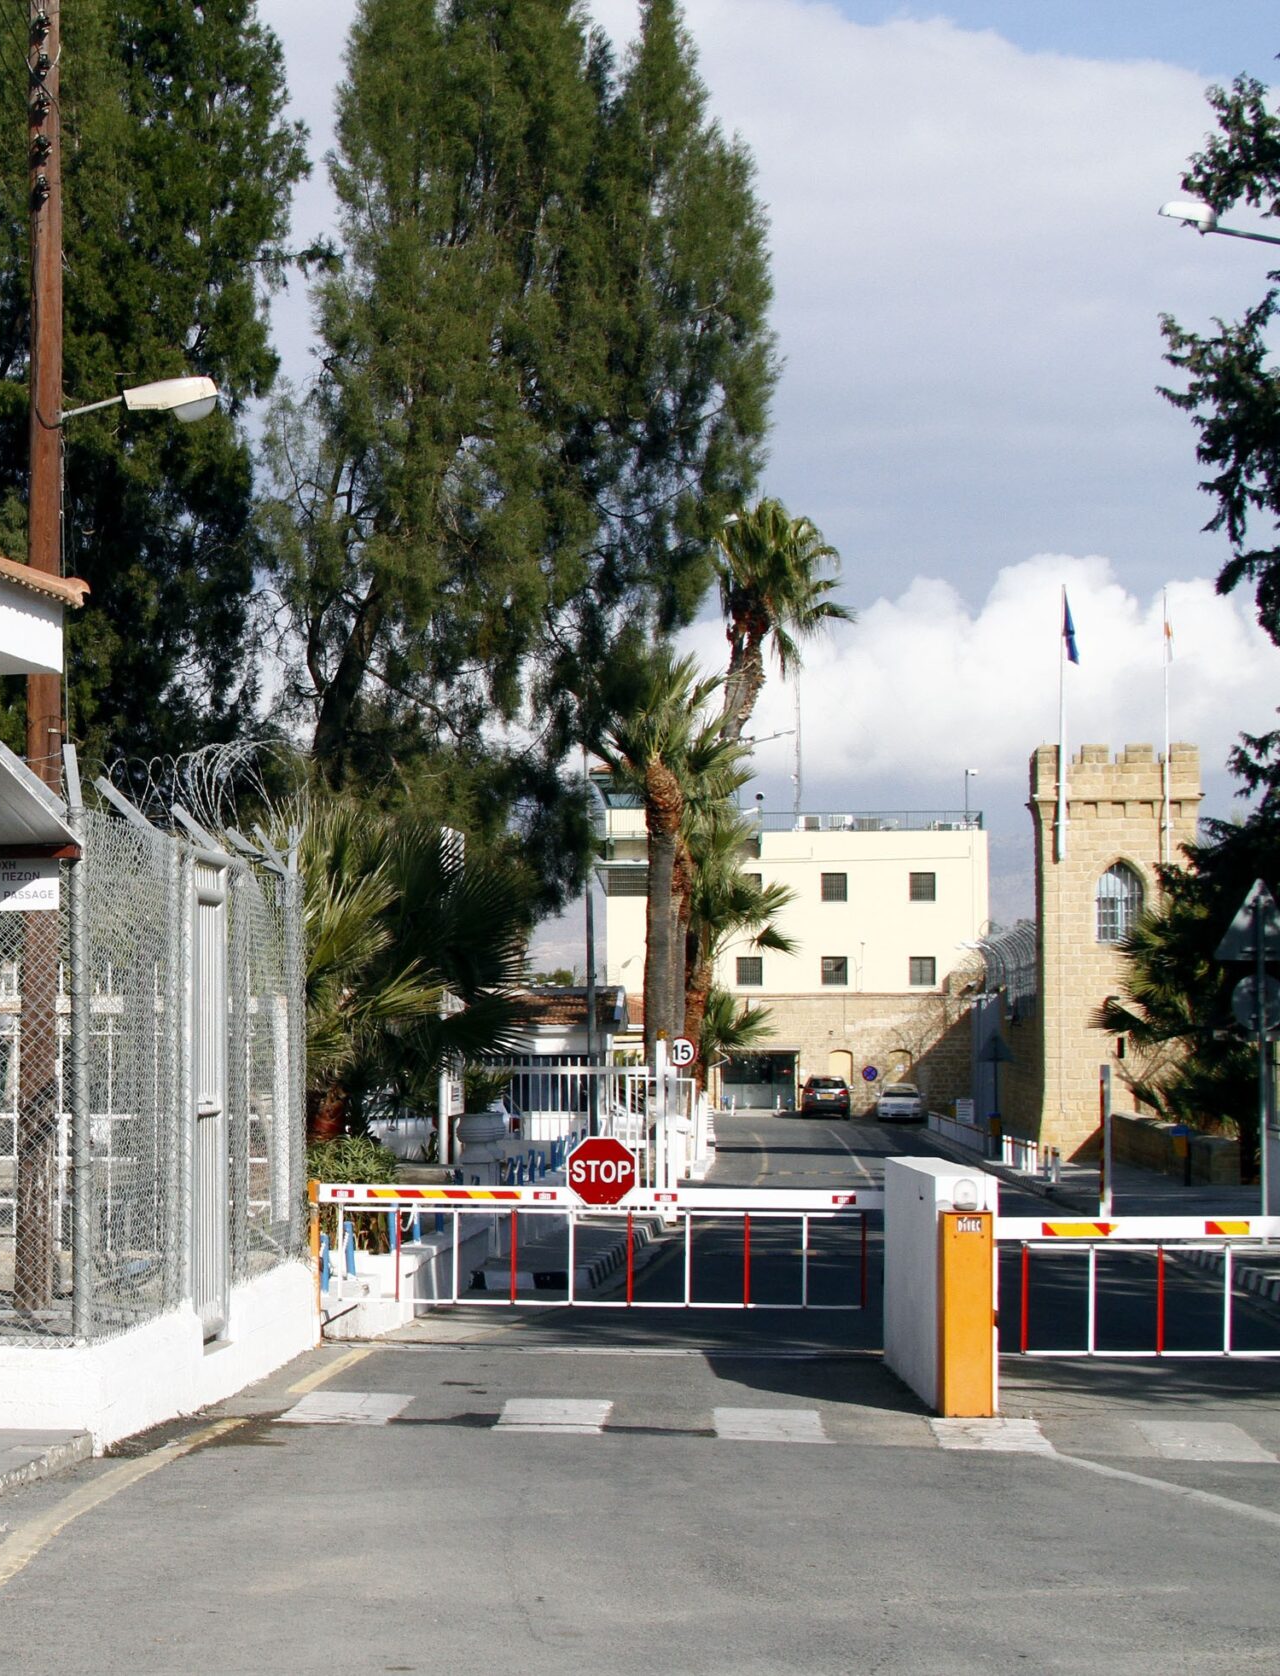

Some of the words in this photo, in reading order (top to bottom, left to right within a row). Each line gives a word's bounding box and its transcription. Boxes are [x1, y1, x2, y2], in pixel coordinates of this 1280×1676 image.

[1, 871, 41, 882] ΠΕΖΩΝ
[3, 889, 55, 900] PASSAGE
[673, 1044, 691, 1060] 15
[572, 1159, 631, 1183] STOP
